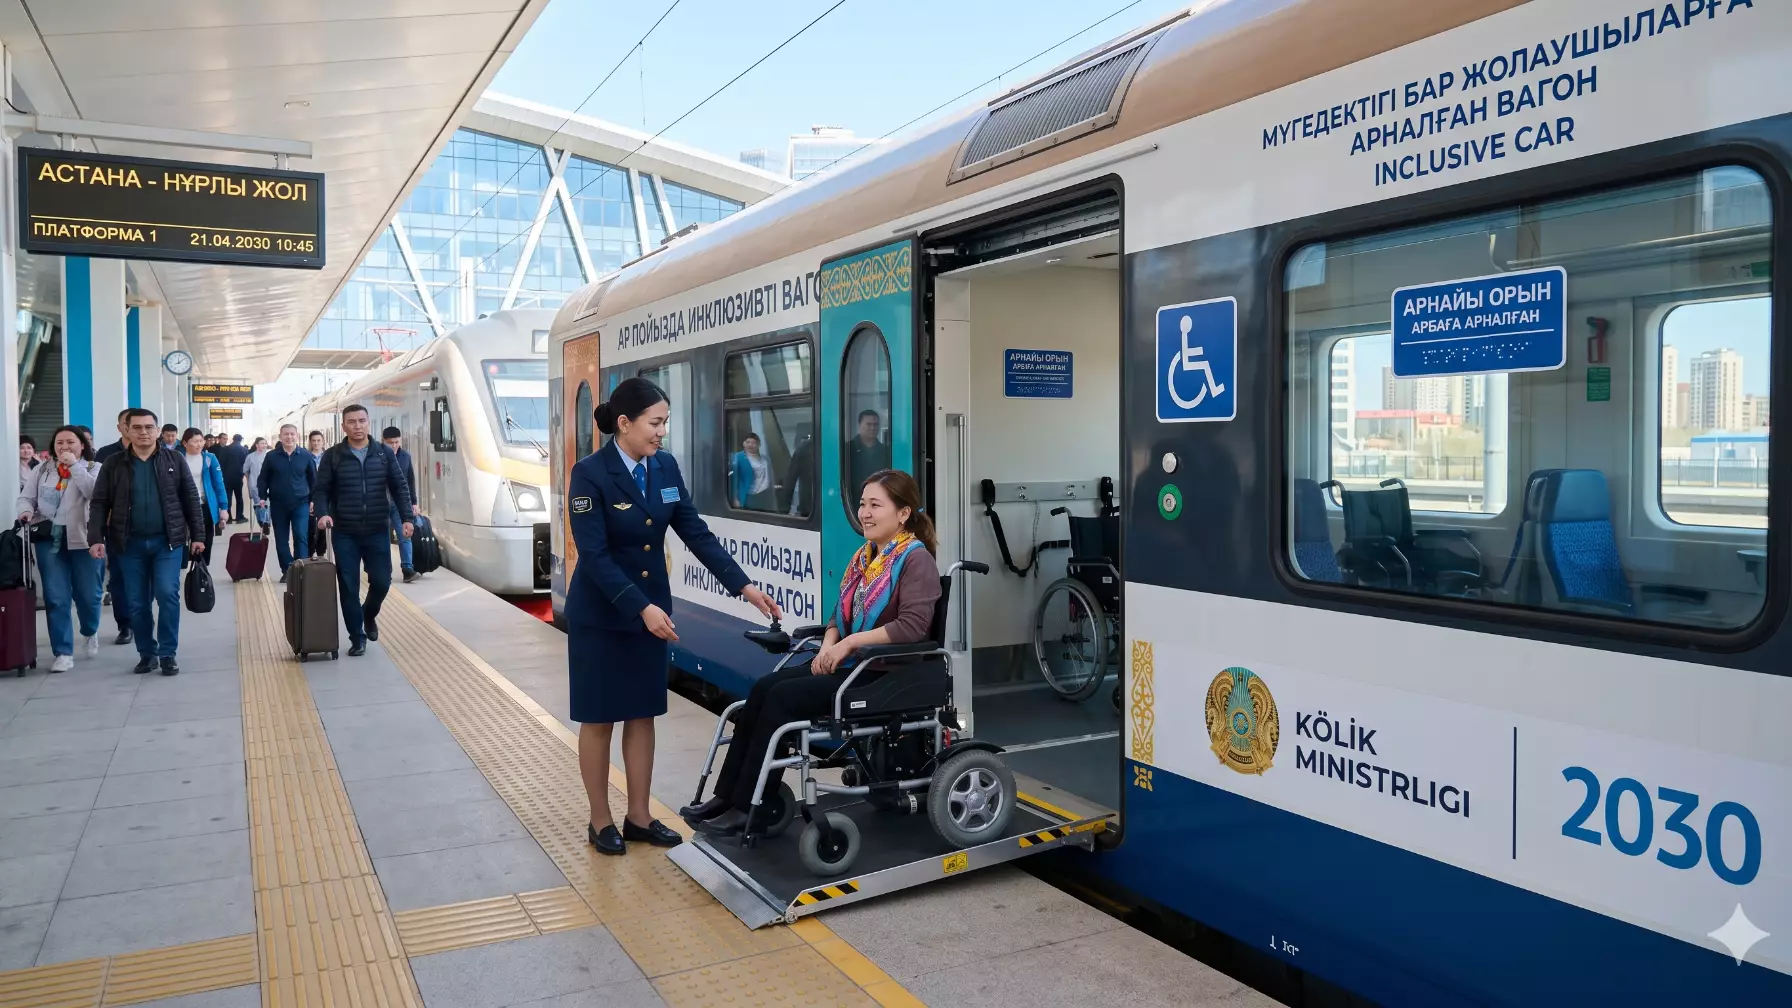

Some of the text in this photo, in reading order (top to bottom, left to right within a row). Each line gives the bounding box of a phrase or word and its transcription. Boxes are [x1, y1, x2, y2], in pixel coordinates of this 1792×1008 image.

[1262, 88, 1397, 150] МҮГЕДЕКТІГІ
[1404, 70, 1456, 108] БАР
[1350, 66, 1600, 156] АРНАЛҒАН ВАГОН
[1375, 116, 1575, 187] INCLUSIVE CAR
[38, 162, 142, 188] АСТАНА
[164, 172, 246, 197] НҰРЛЫ
[253, 180, 308, 201] ЖОЛ
[34, 223, 314, 252] ПЛАТФОРМА 1 21.04.2030 10:45
[618, 327, 631, 350] АР
[632, 309, 686, 346] ПОЙЫЗДА
[687, 282, 777, 334] ИНКЛЮЗИВТІ
[1403, 281, 1552, 317] АРНАЙЫ ОРЫН
[1411, 309, 1541, 335] АРБАҒА АРНАЛҒАН
[741, 537, 815, 582] ПОЙЫЗДА
[766, 583, 815, 620] ВАГОН
[1296, 744, 1470, 818] MINISTRLIGI
[1562, 766, 1762, 886] 2030
